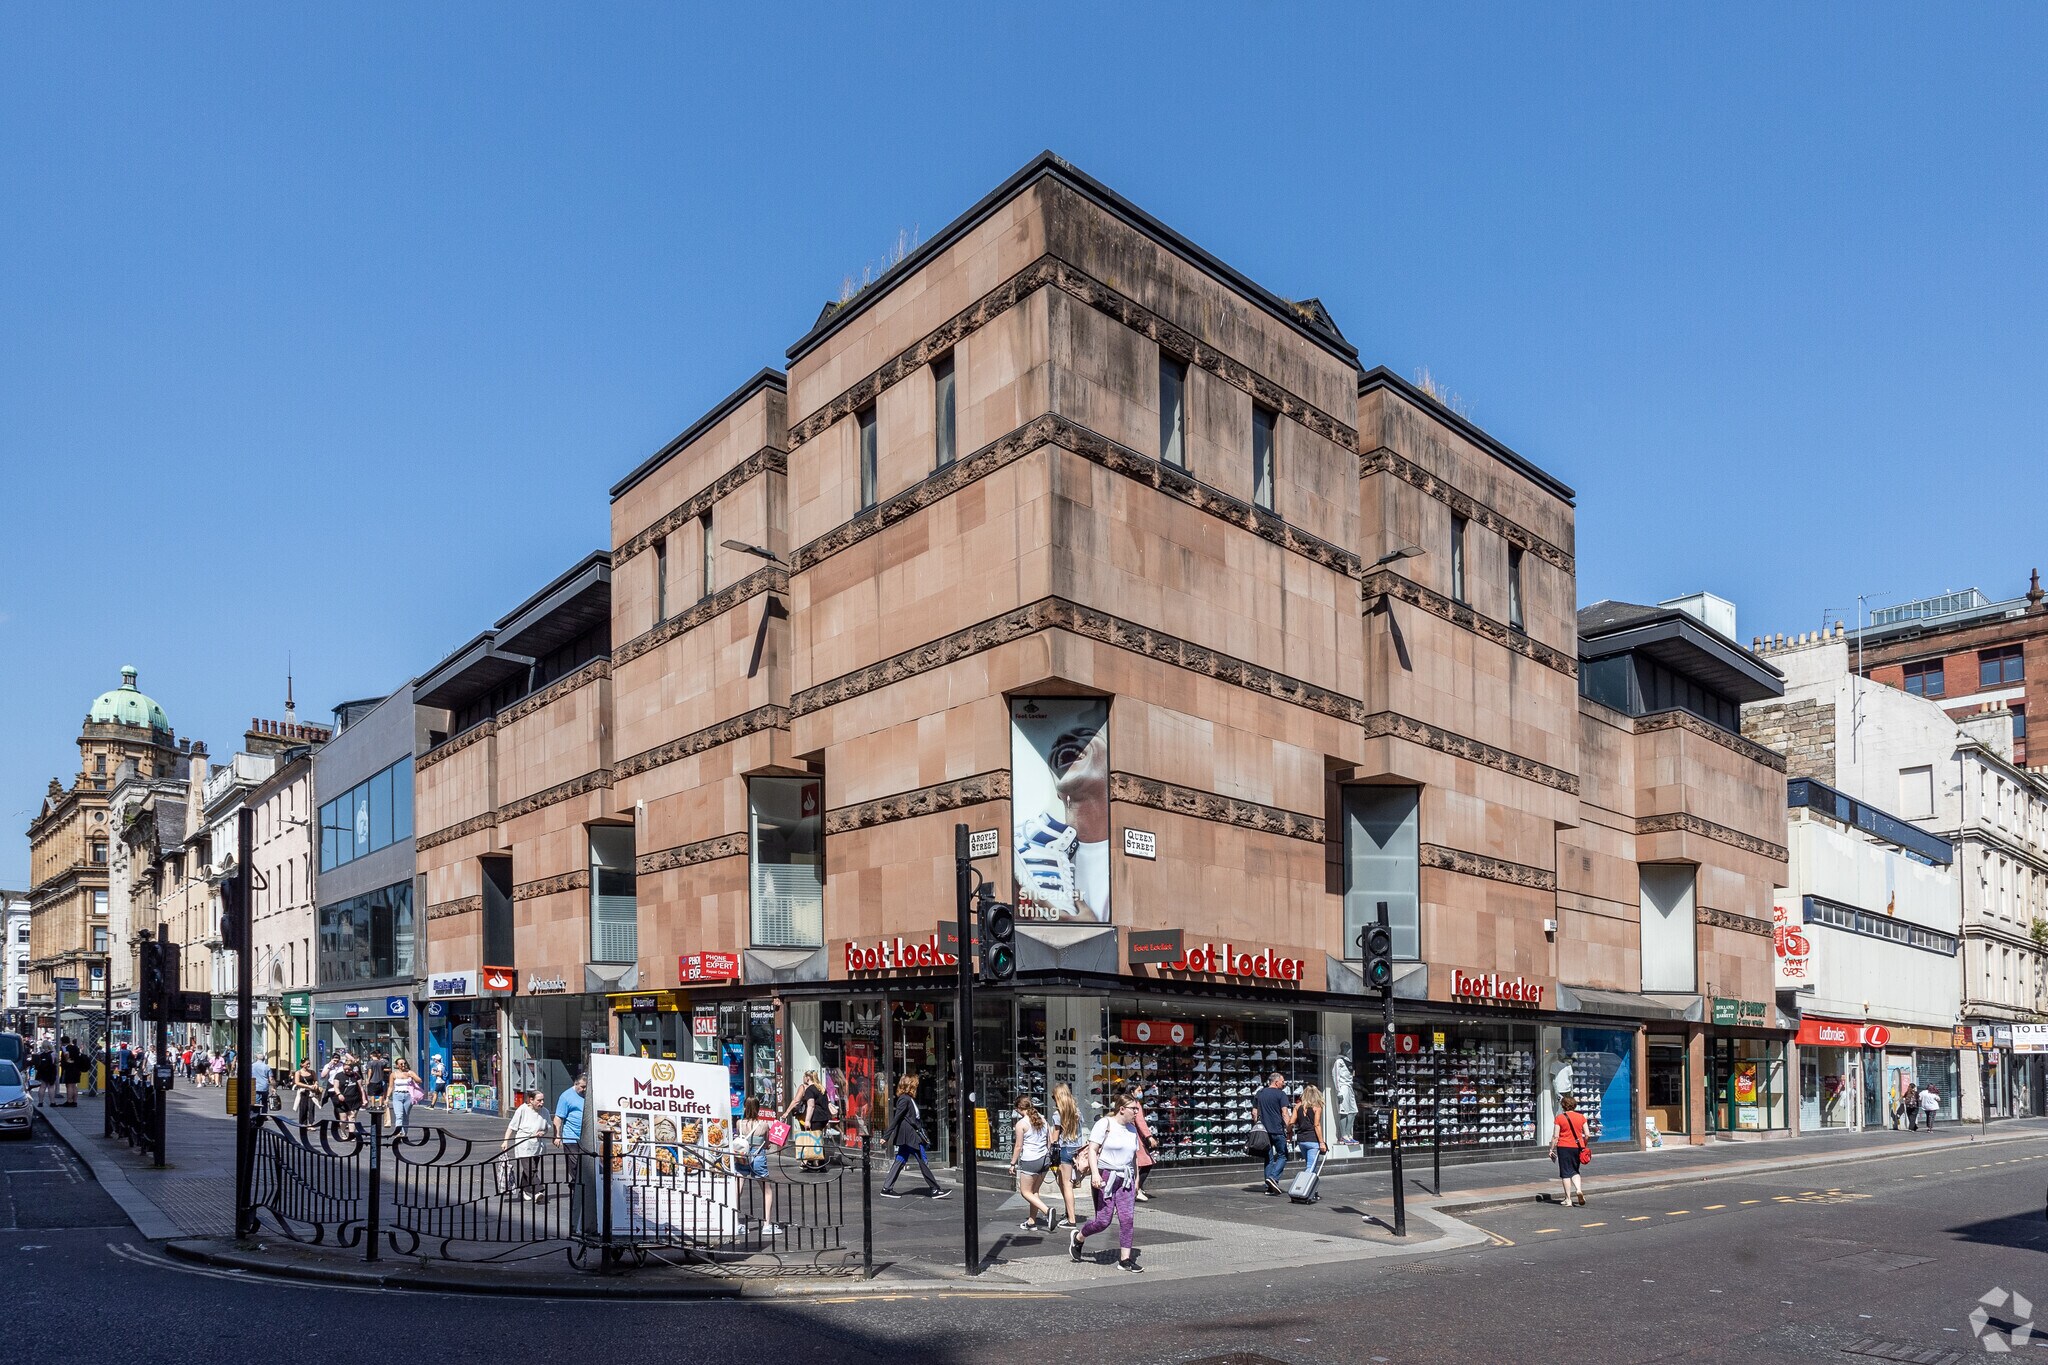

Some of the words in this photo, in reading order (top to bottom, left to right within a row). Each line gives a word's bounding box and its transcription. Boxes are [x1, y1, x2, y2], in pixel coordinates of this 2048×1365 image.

[971, 832, 997, 843] ARGYLE
[1127, 830, 1153, 843] QUEEN
[971, 841, 996, 852] STREET
[1126, 839, 1154, 852] STREET
[1018, 884, 1086, 901] sneaker
[1018, 903, 1060, 921] thing
[1133, 943, 1149, 952] Foot
[1149, 943, 1174, 951] Locker
[845, 941, 889, 971] Foot
[1222, 943, 1305, 981] Locker
[705, 961, 734, 969] EXPERT
[1451, 969, 1490, 997] Foot
[1491, 973, 1544, 1002] Locker
[633, 998, 655, 1008] Premier
[696, 1018, 717, 1034] SALE
[823, 1020, 854, 1034] MEN
[855, 1028, 880, 1036] adidas
[1819, 1025, 1845, 1042] Ladbrokes
[2015, 1025, 2031, 1033] TO
[1871, 1026, 1882, 1044] L
[633, 1077, 695, 1100] Marble
[617, 1096, 665, 1111] Global
[668, 1100, 711, 1115] Buffet
